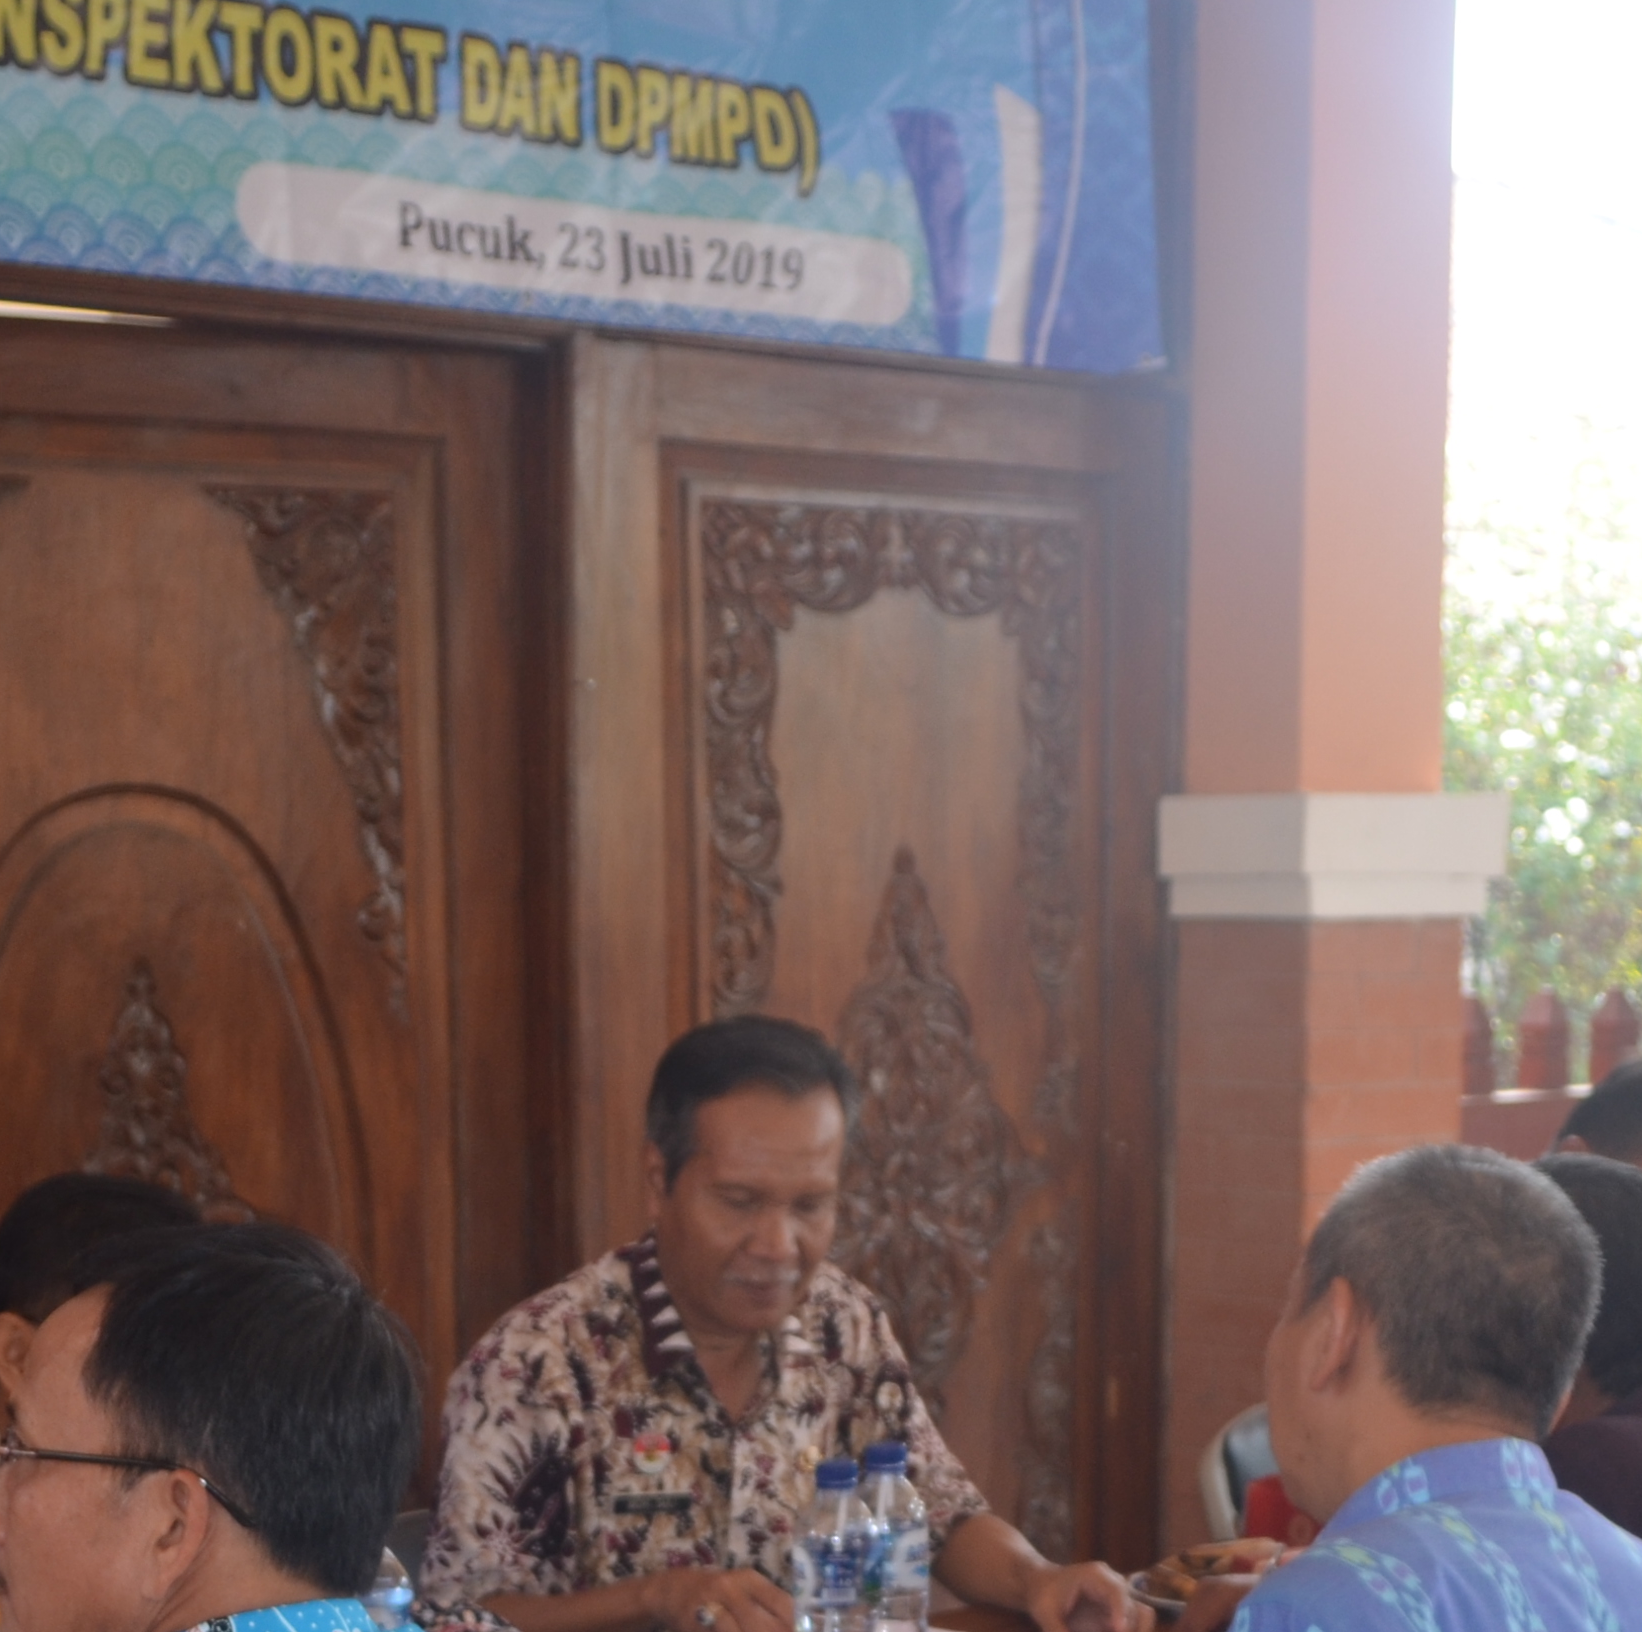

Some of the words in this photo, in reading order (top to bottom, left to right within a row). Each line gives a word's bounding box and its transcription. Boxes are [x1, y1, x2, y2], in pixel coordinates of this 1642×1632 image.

[460, 32, 582, 147] DAN
[593, 57, 821, 197] DPMPD)
[398, 200, 546, 272] Pucuk,
[559, 222, 606, 273] 23
[620, 230, 693, 287] Juli
[706, 238, 805, 292] 2019
